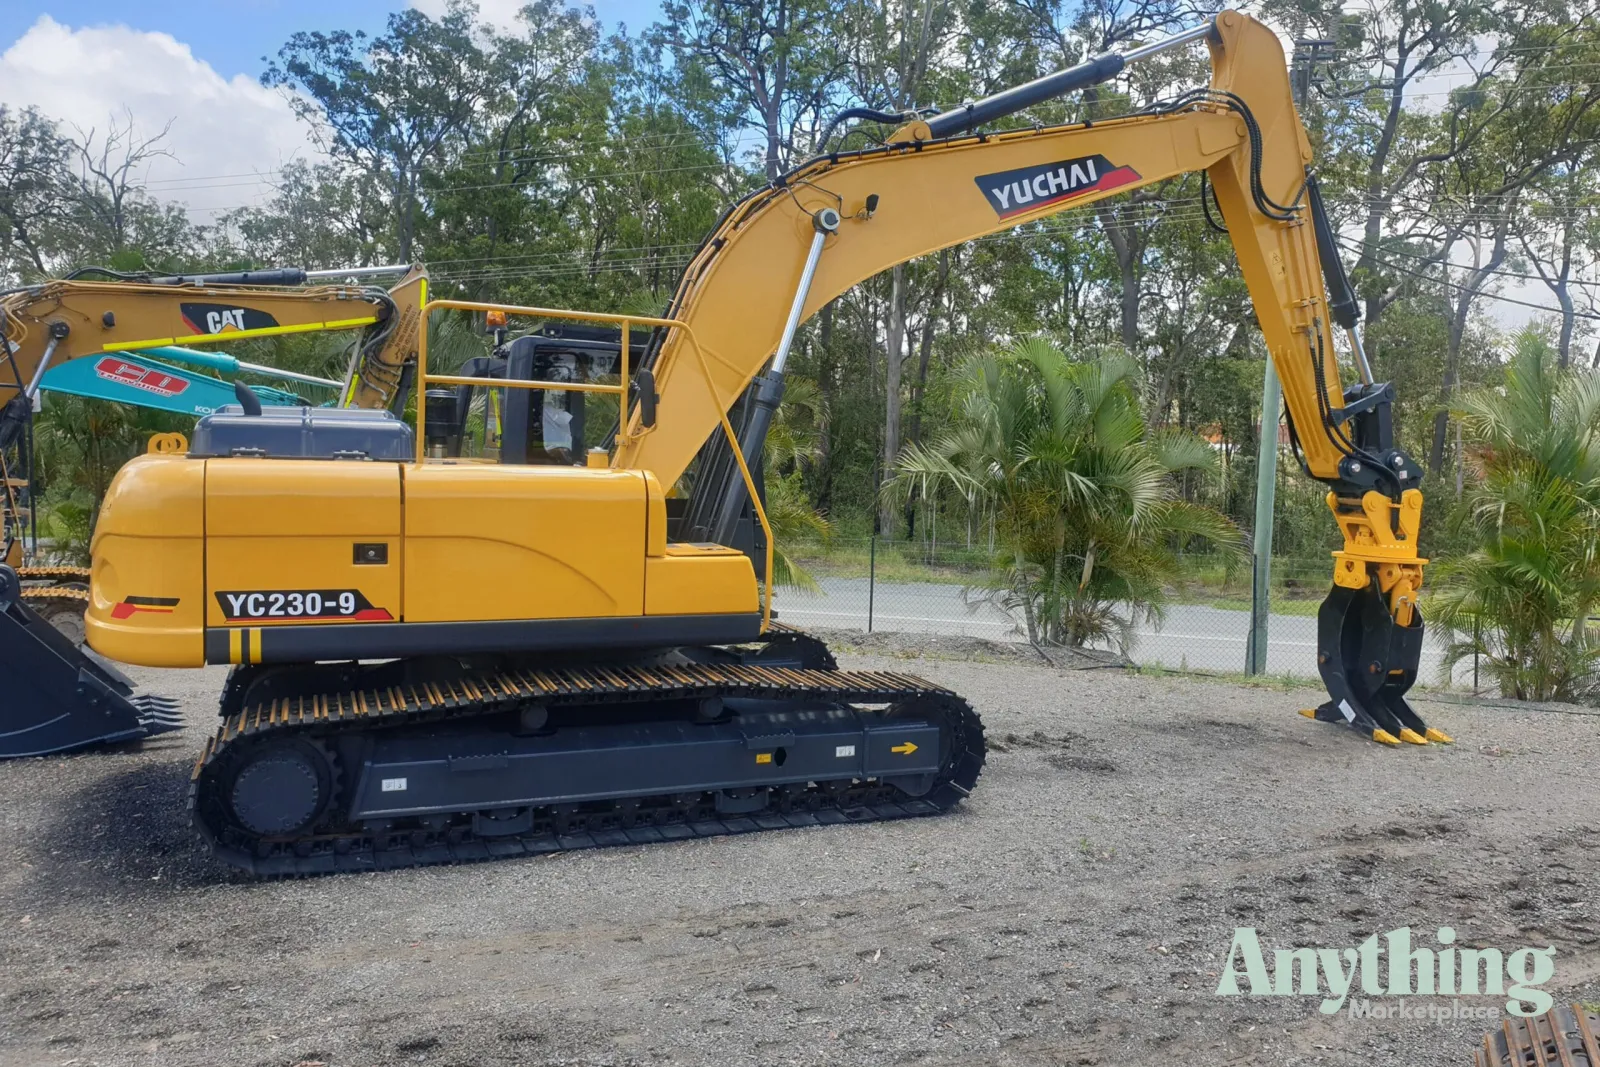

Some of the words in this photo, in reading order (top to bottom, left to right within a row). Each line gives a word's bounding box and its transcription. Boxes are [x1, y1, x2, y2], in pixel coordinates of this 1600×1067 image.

[992, 159, 1098, 209] YUCHAI
[206, 309, 245, 334] CAT
[226, 593, 355, 617] YC230-9
